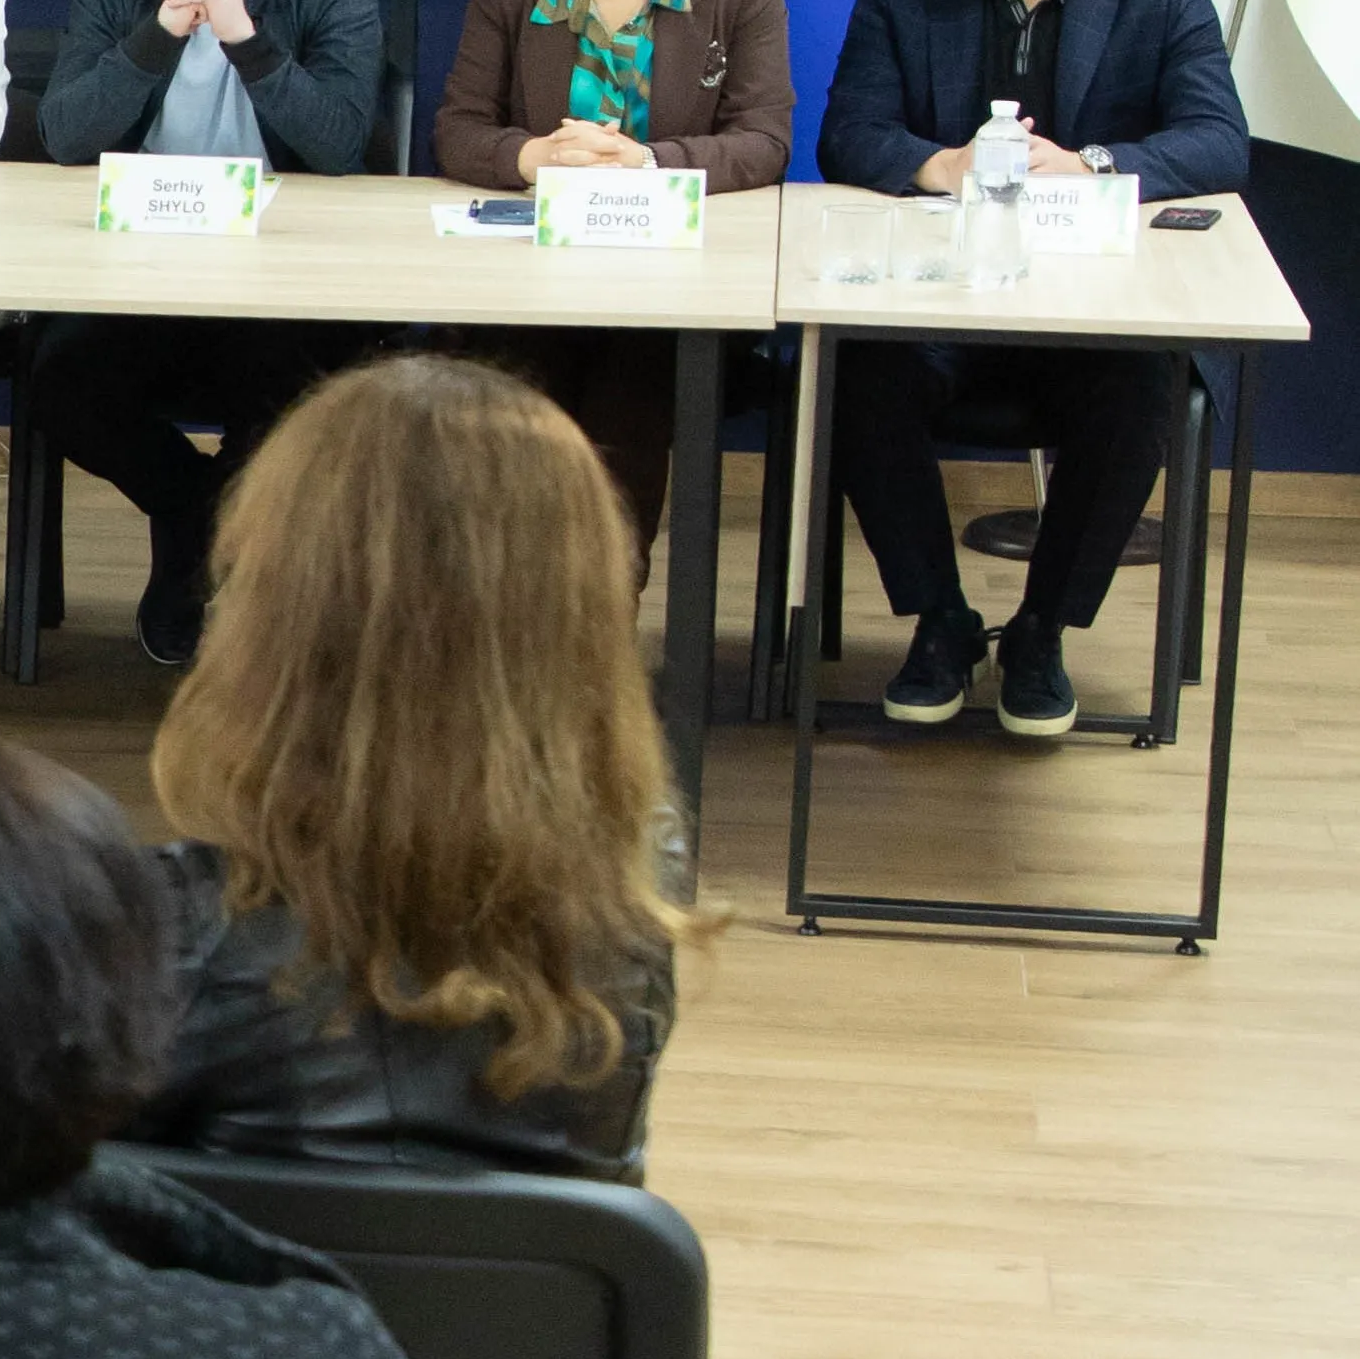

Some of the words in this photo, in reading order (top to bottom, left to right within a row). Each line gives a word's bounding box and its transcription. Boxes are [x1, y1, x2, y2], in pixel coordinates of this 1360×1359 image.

[152, 179, 204, 196] Serhiy
[148, 199, 206, 214] SHYLO
[588, 192, 650, 206] Zinaida
[586, 212, 650, 227] BOYKO
[1036, 212, 1074, 227] UTS
